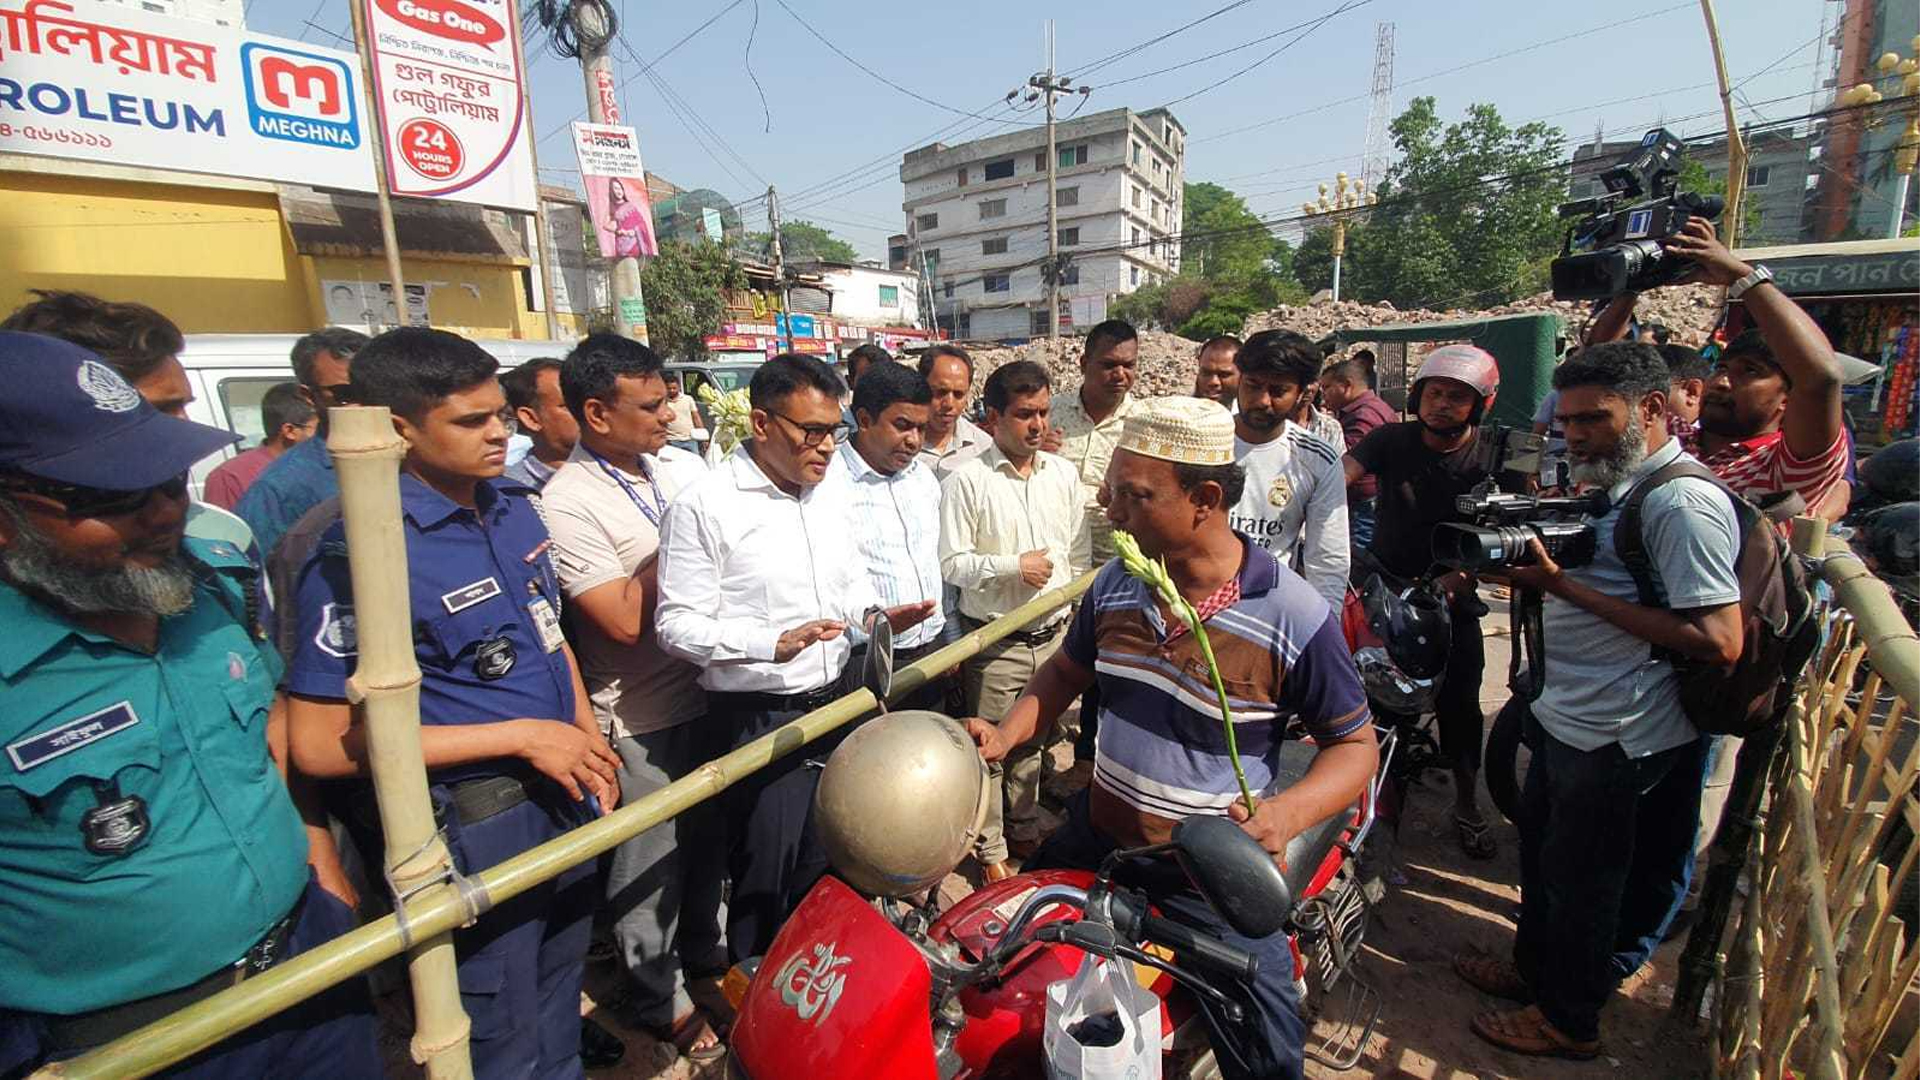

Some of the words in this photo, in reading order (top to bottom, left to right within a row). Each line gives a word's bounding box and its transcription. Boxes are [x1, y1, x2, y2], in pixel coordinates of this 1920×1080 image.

[397, 0, 441, 23] Gas
[443, 11, 487, 35] One
[395, 63, 434, 84] গুল
[440, 73, 491, 99] গফুর
[393, 88, 500, 123] পেট্রোলিয়াম
[258, 116, 356, 147] MEGHNA
[413, 126, 448, 151] 24
[412, 150, 453, 164] HOURS
[418, 161, 452, 174] OPEN
[1833, 259, 1898, 285] পান
